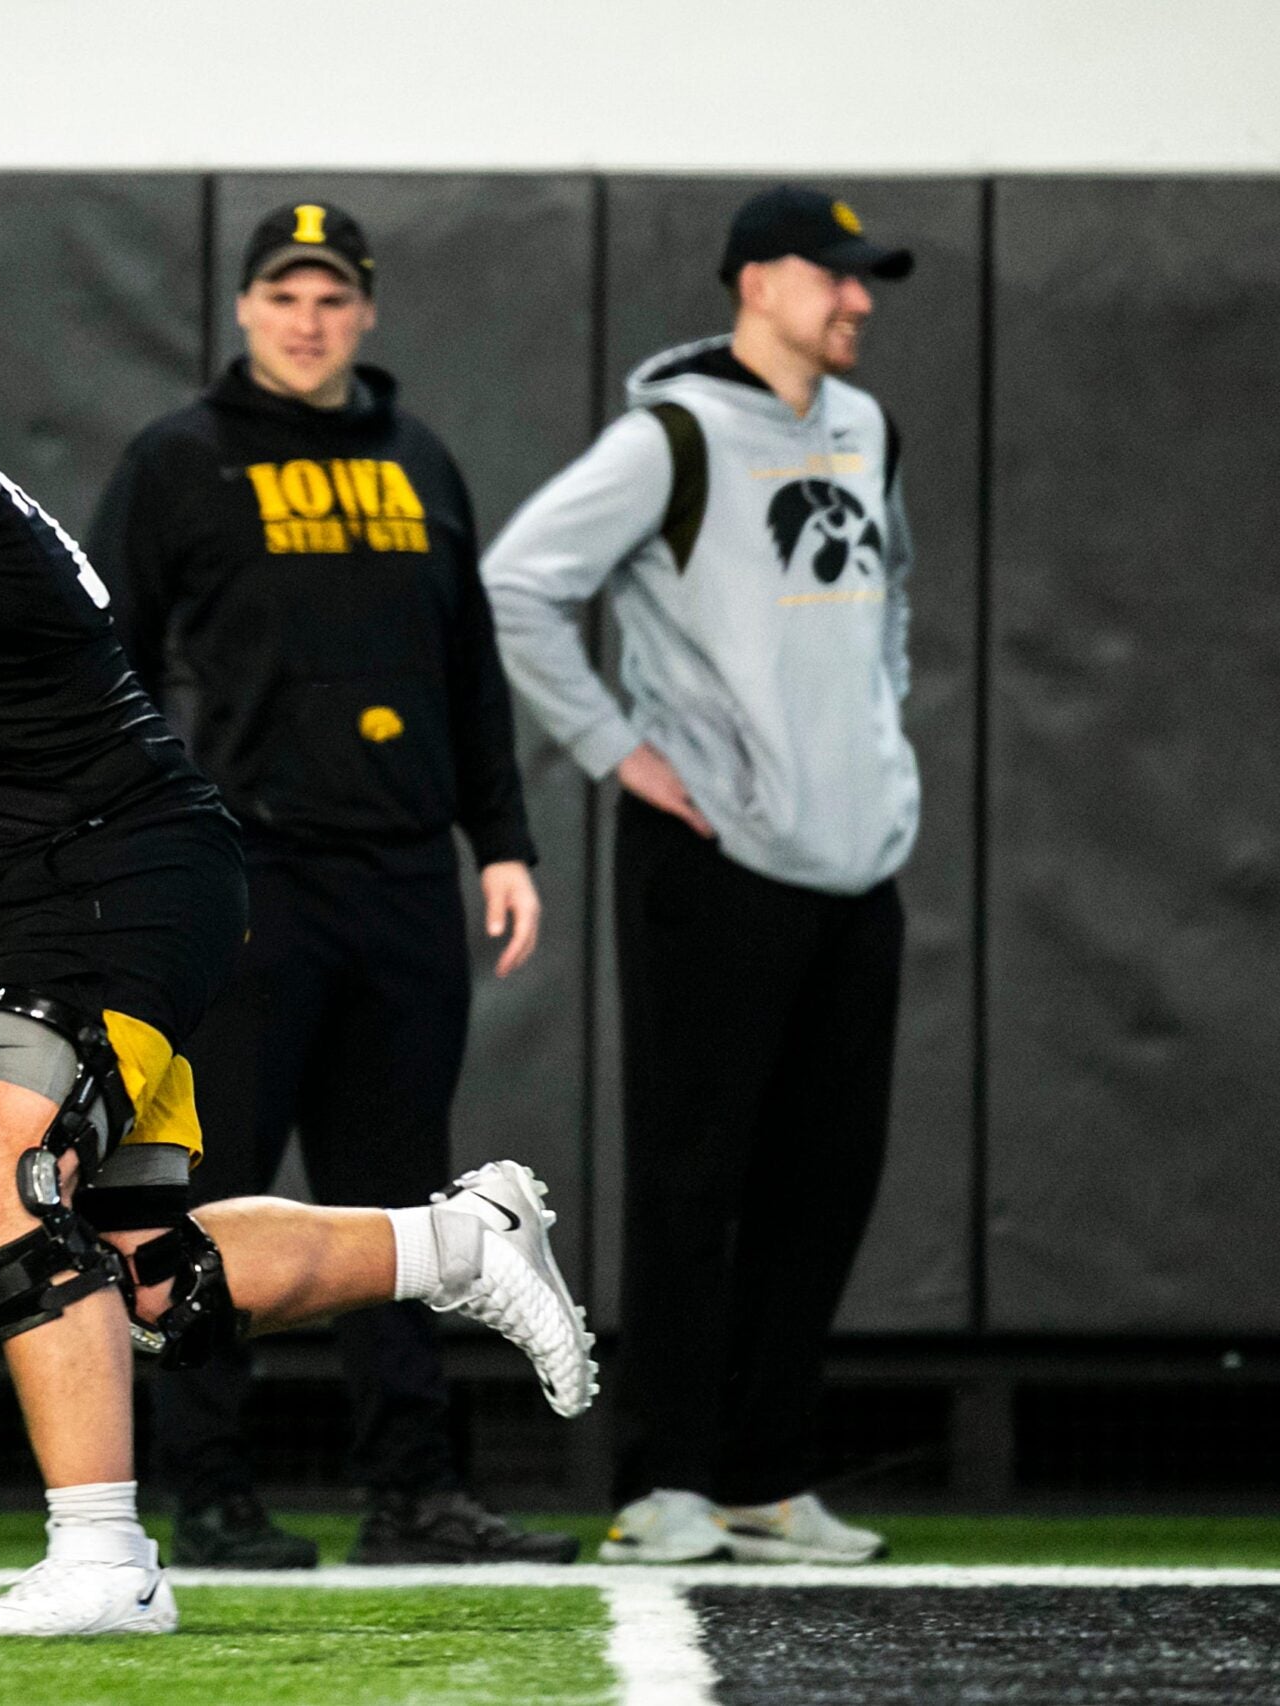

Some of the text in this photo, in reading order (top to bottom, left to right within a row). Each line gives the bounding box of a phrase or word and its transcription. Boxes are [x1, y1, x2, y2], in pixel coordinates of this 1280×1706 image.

[292, 204, 327, 243] I
[246, 457, 425, 520] IOWA
[264, 518, 430, 554] STREGTH
